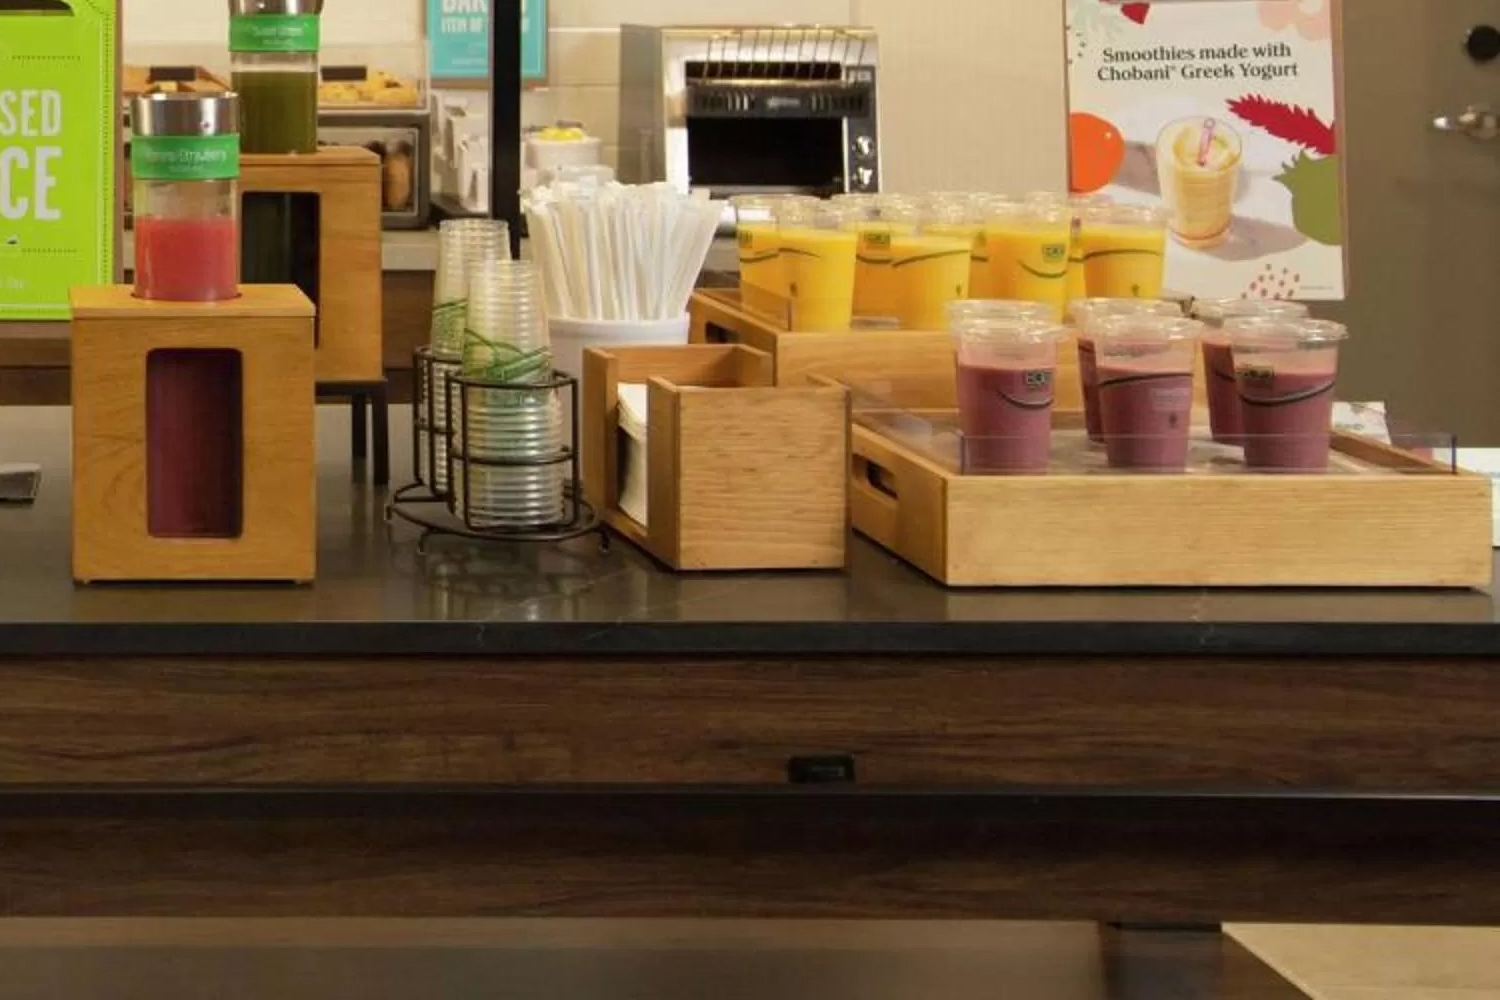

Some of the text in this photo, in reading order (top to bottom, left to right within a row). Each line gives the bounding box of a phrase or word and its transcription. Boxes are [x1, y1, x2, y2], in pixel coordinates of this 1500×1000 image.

[1102, 41, 1292, 63] Smoothies made with
[1180, 62, 1236, 79] Greek
[1239, 61, 1300, 80] Yogurt
